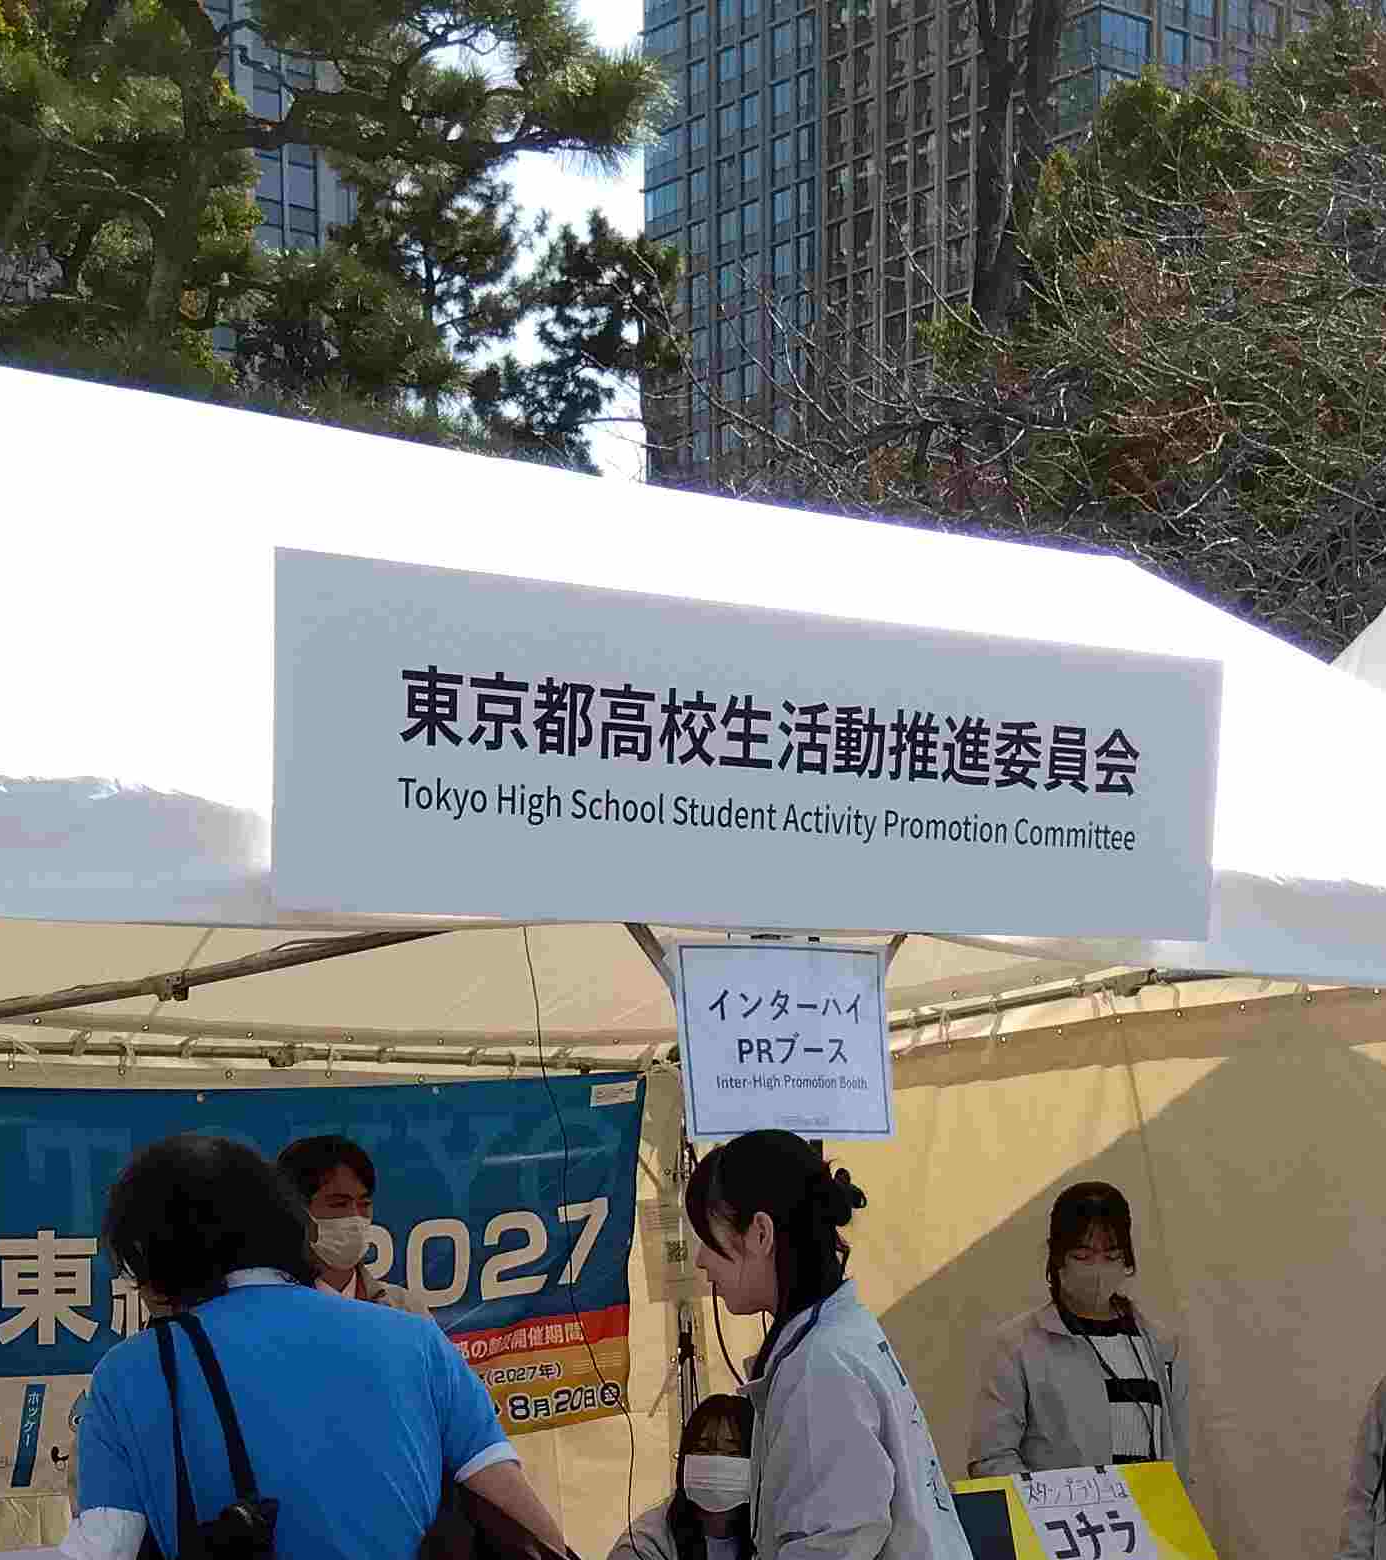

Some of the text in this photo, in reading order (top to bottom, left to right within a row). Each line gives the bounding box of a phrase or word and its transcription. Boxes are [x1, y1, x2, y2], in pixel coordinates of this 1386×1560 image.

[400, 667, 1140, 796] 東京都高校生活動推進委員会
[398, 777, 1136, 851] Tokyo High School Student Activity Promotion Committee
[709, 988, 862, 1025] インターハイ
[737, 1031, 848, 1065] PRブース
[716, 1073, 868, 1092] Inter-High Promotion Booth
[481, 1361, 562, 1386] (2027年)
